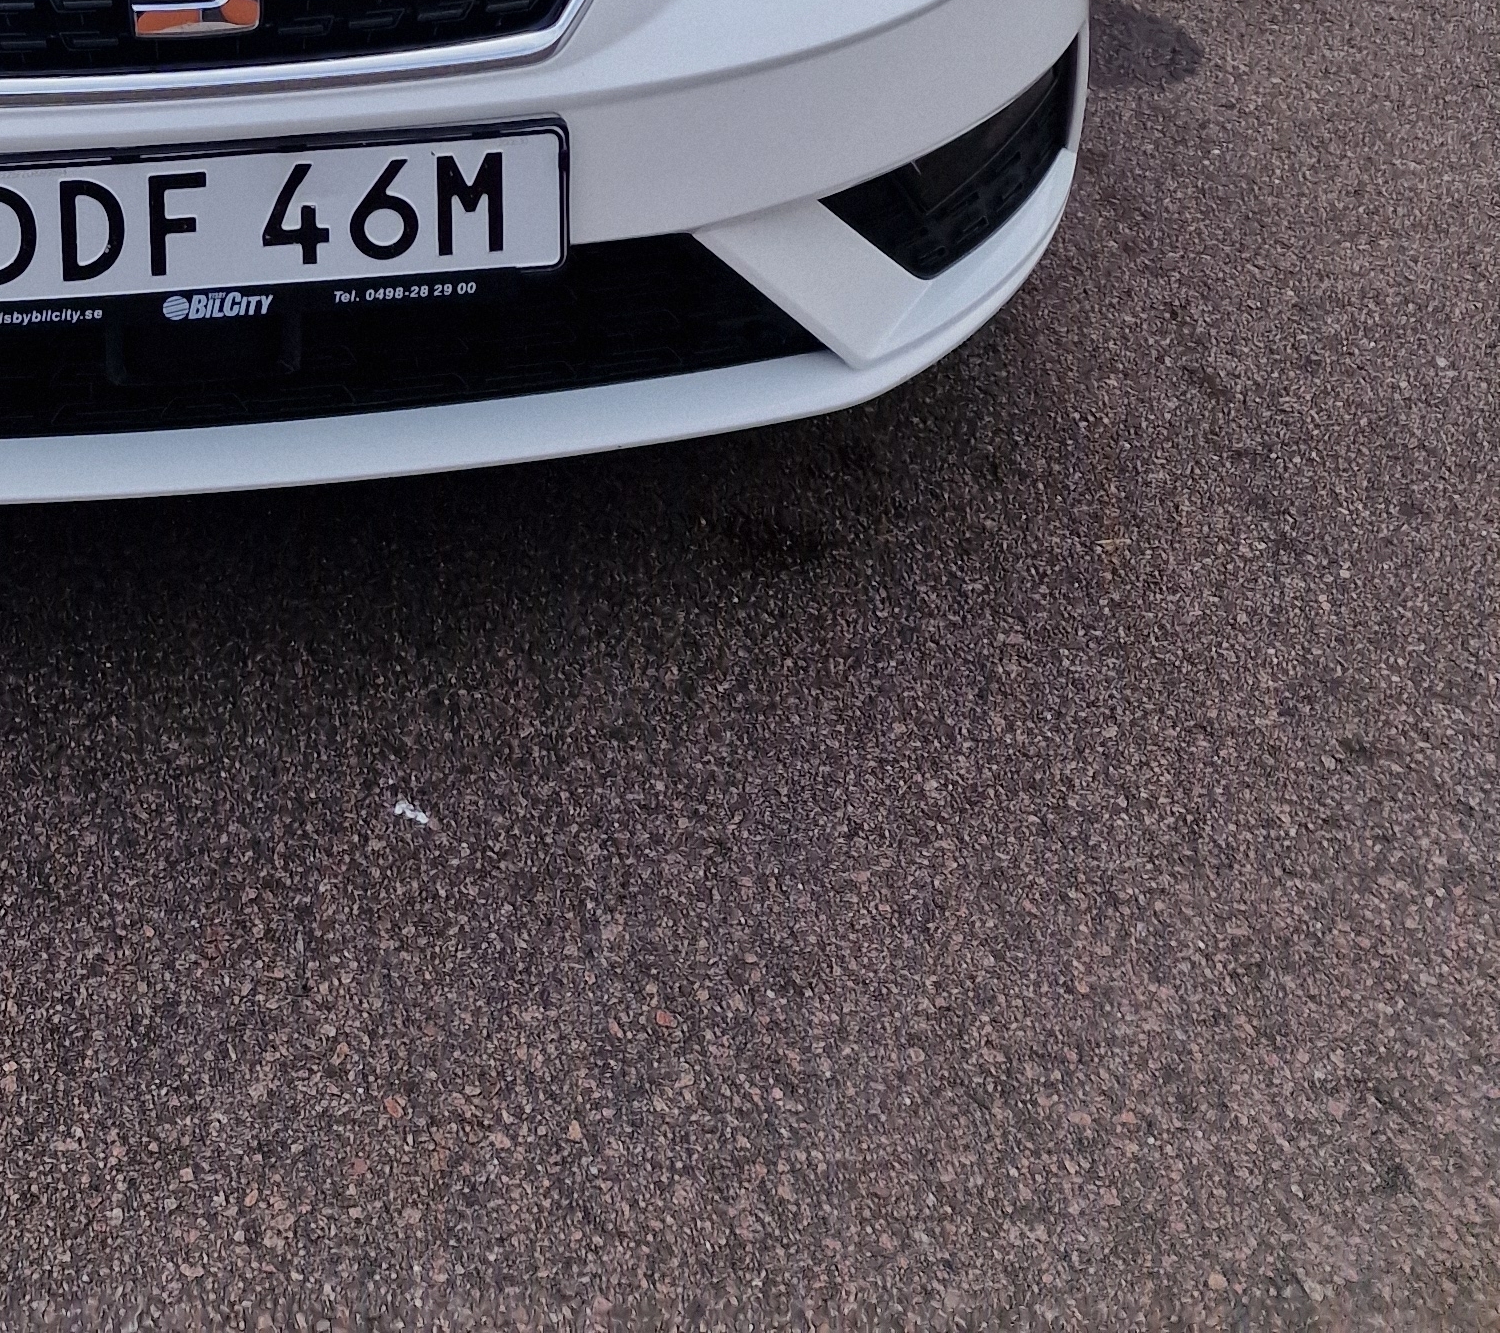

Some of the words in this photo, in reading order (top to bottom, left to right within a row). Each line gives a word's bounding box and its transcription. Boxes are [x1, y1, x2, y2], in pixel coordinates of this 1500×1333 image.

[262, 150, 504, 265] 46M
[334, 290, 359, 304] Tel.
[365, 285, 429, 302] 0498-28
[433, 284, 453, 298] 29
[457, 281, 477, 295] 00
